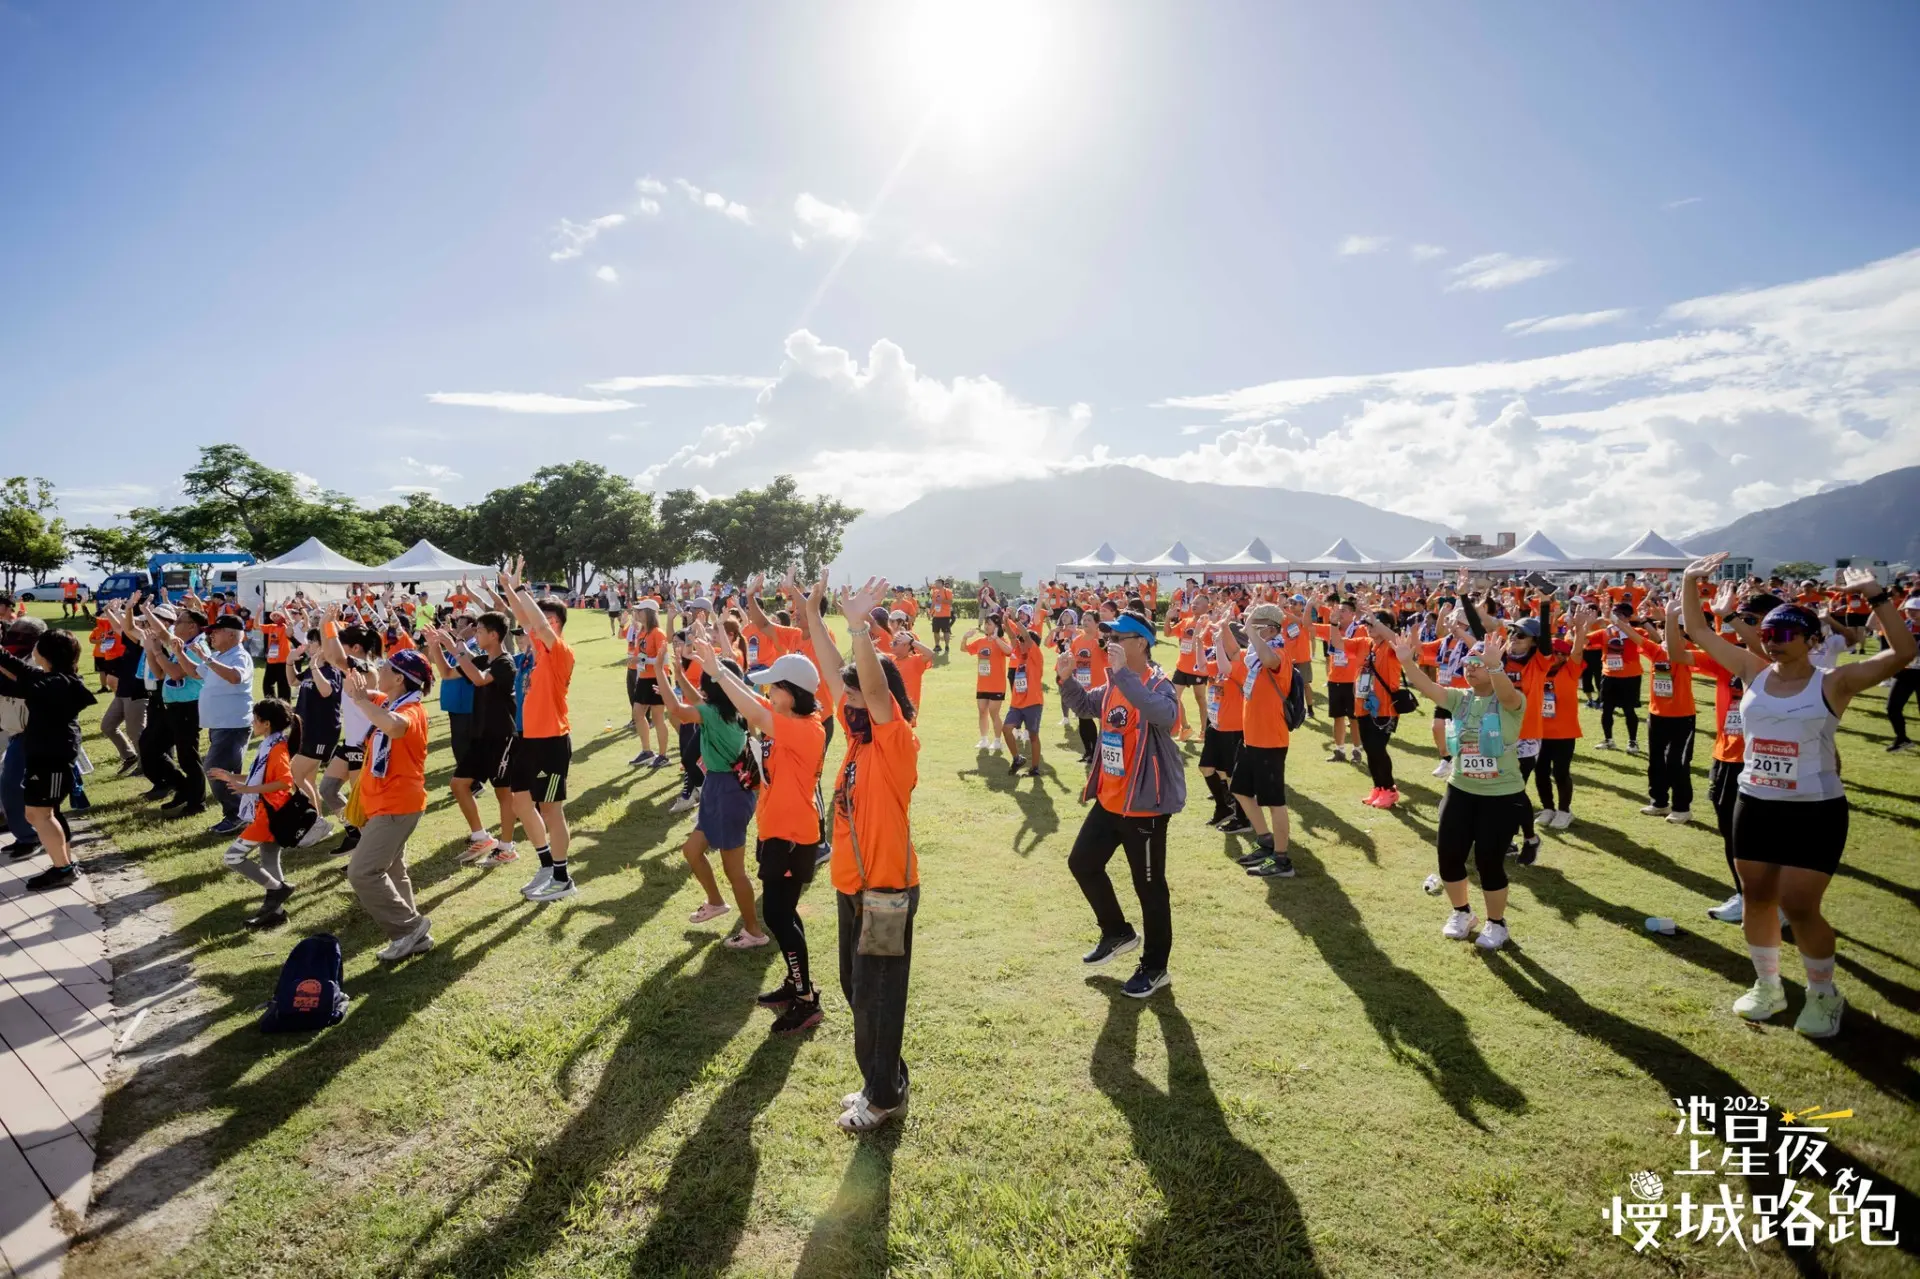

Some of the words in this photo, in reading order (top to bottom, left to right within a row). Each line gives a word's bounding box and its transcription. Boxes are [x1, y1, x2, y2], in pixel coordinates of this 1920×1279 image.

[1102, 749, 1121, 763] 0657
[1463, 758, 1494, 768] 2018
[1753, 758, 1793, 774] 2017
